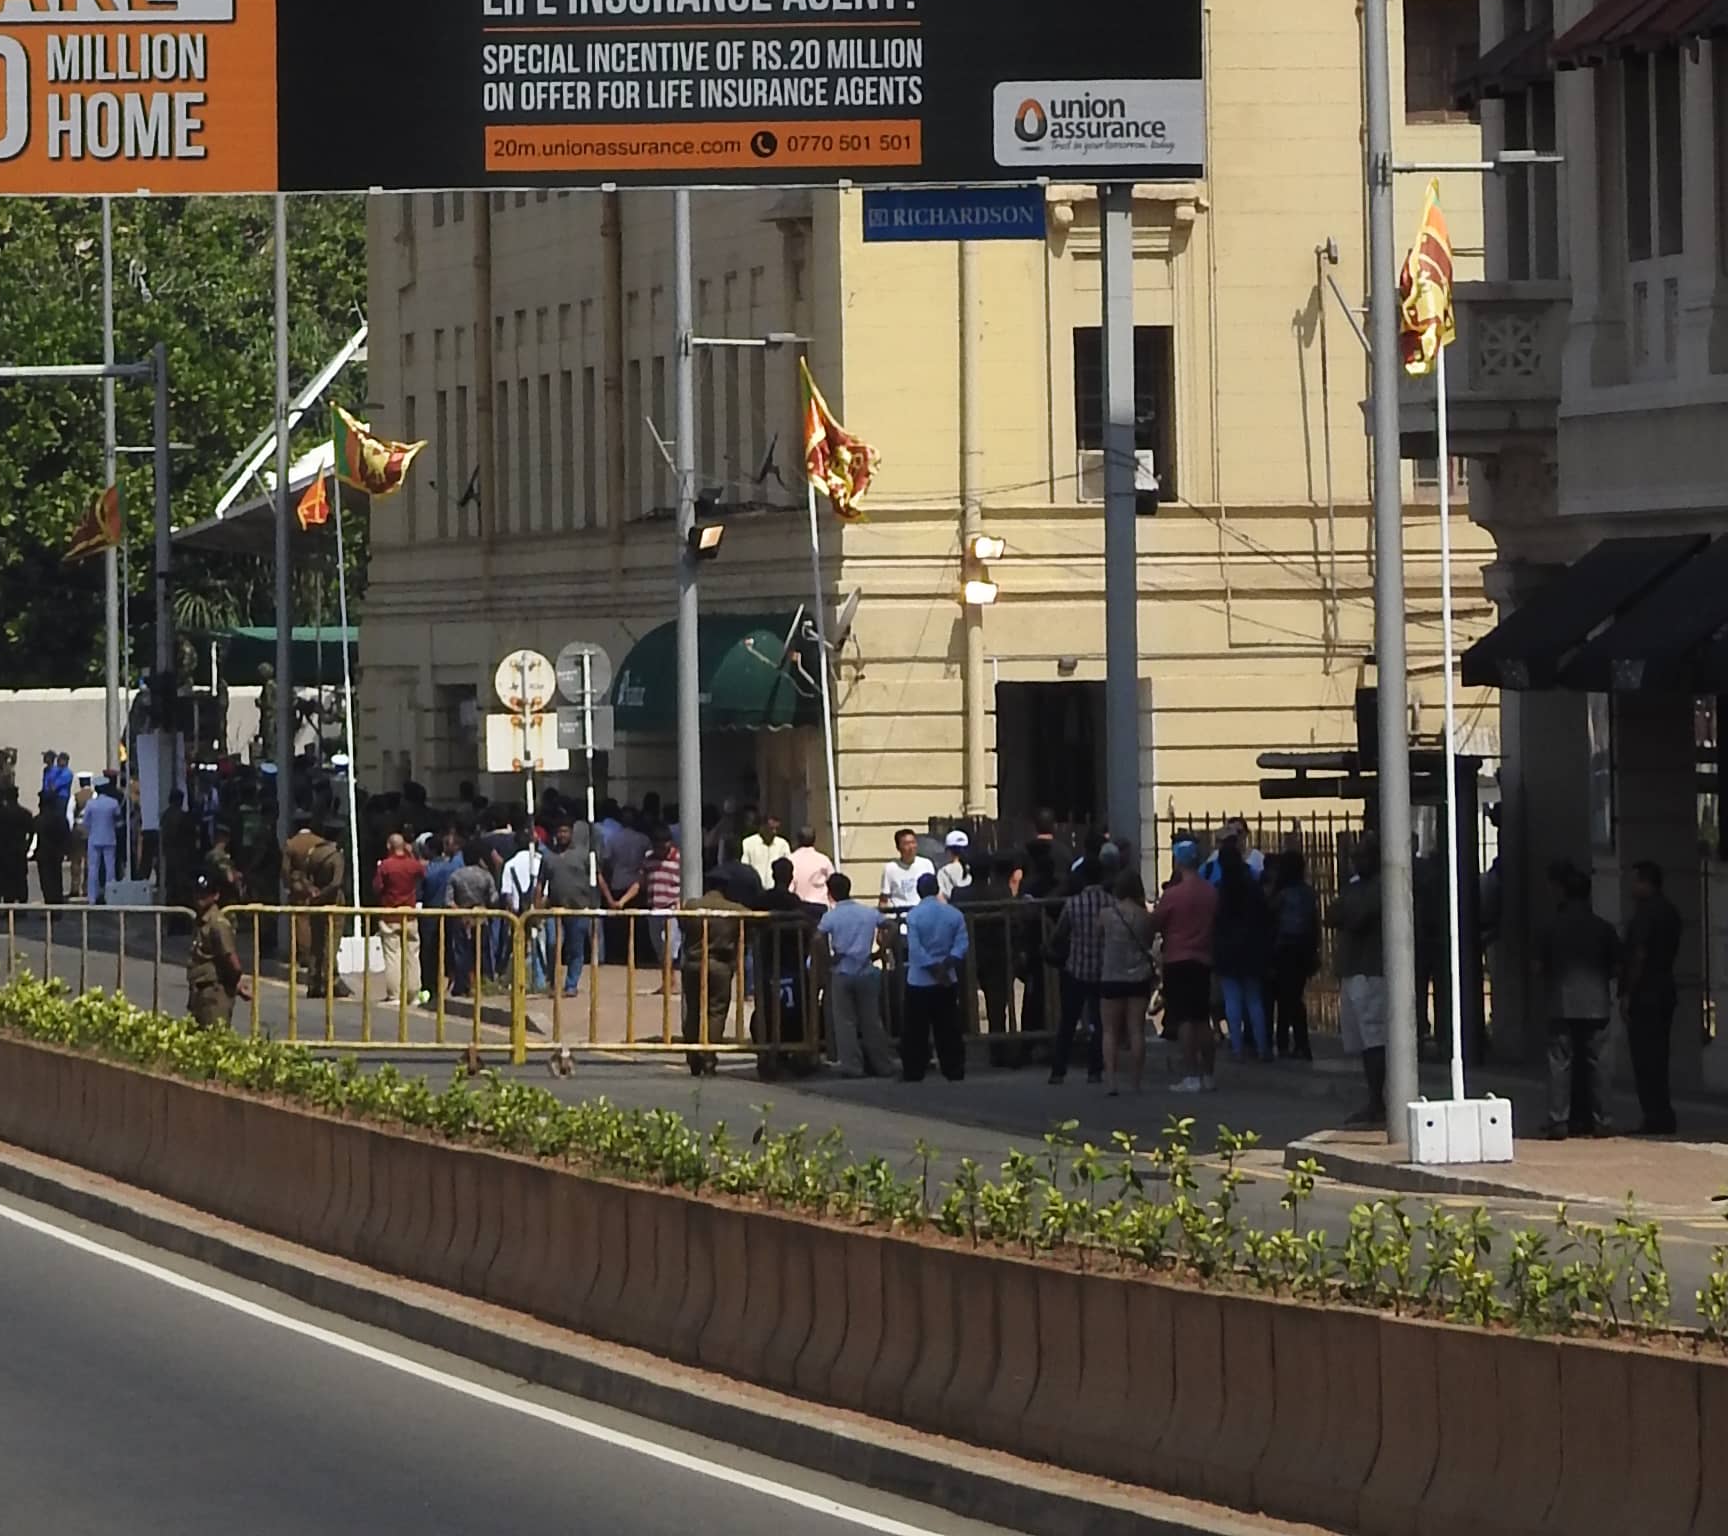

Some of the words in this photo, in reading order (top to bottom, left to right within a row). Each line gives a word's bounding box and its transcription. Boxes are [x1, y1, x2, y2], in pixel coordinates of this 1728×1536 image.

[47, 33, 206, 82] MILLION
[483, 44, 580, 75] SPECIAL
[587, 41, 709, 72] INCENTIVE
[716, 41, 746, 71] OF
[752, 39, 821, 70] RS.20
[827, 38, 922, 69] MILLION
[483, 82, 514, 111] ON
[520, 80, 591, 111] OFFER
[598, 80, 639, 110] FOR
[647, 79, 693, 109] LIFE
[700, 77, 827, 108] INSURANCE
[834, 75, 923, 106] AGENTS
[1050, 92, 1126, 119] union
[47, 92, 206, 160] HOME
[1050, 118, 1167, 139] assurance
[493, 138, 741, 157] 20m.unionassurance.com
[787, 136, 833, 153] 0770
[839, 135, 872, 151] 501
[879, 134, 912, 151] 501
[893, 206, 1034, 226] RICHARDSON
